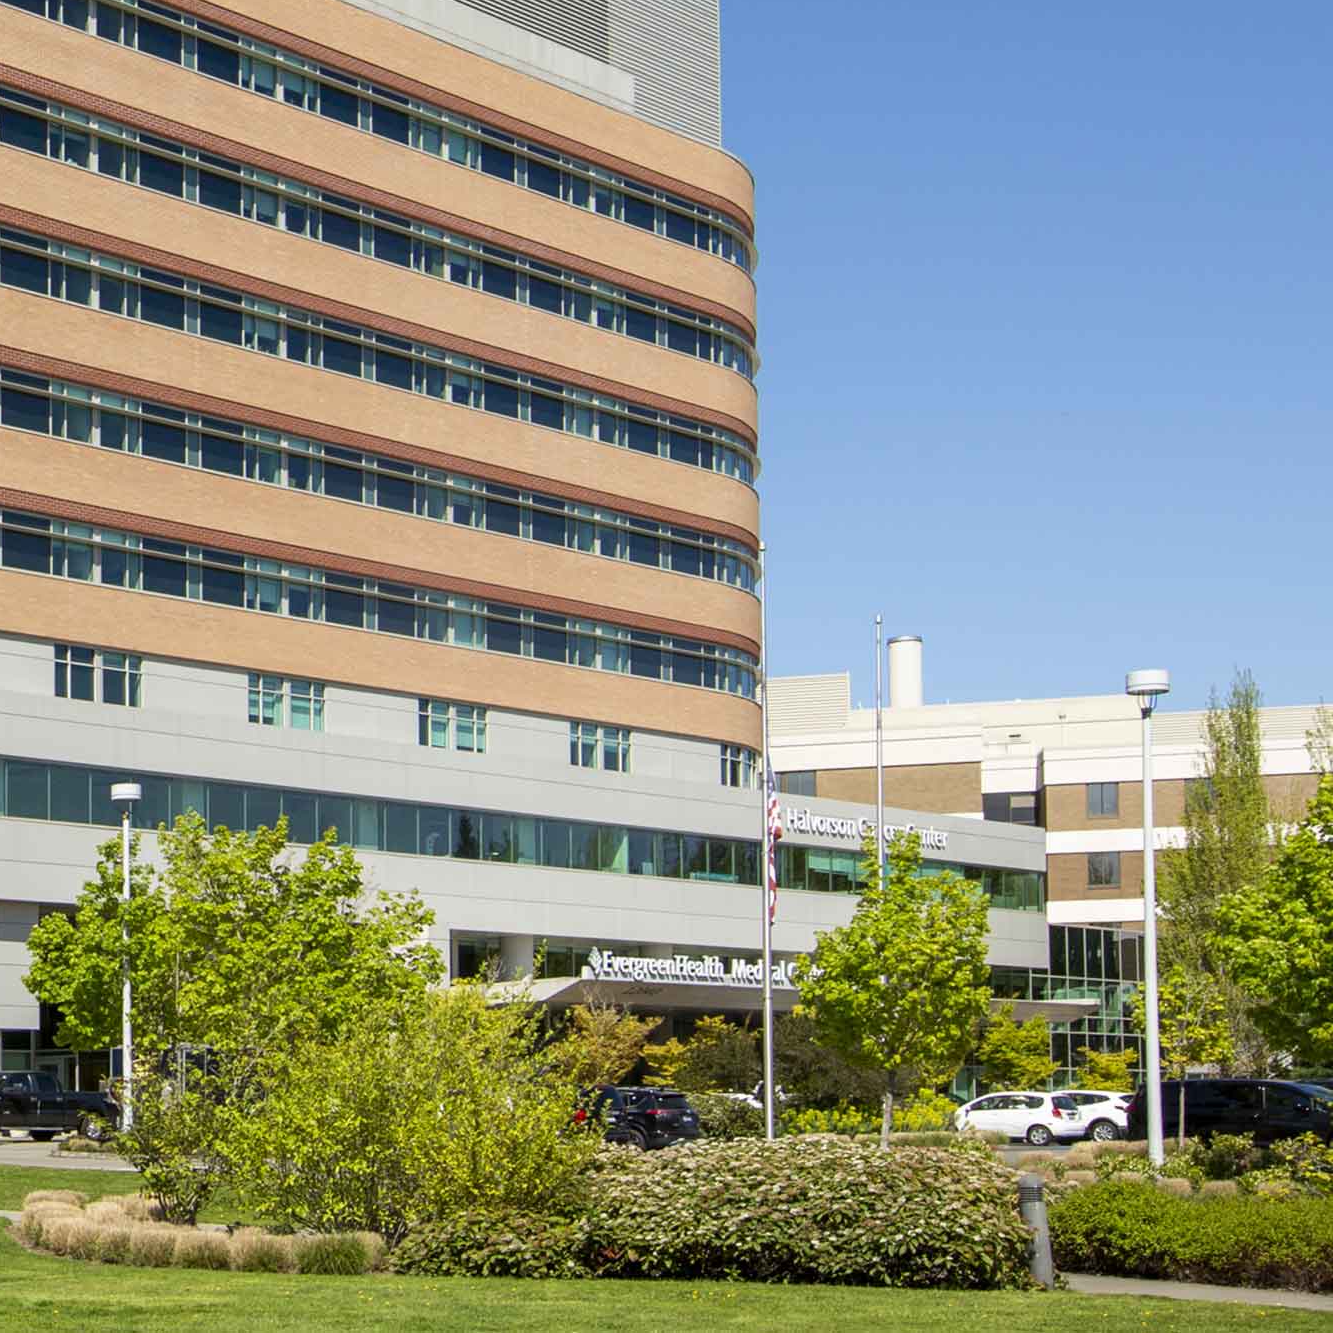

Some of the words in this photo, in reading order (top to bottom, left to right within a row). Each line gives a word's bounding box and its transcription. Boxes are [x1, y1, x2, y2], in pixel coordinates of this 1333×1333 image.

[786, 807, 855, 836] Halvorson
[602, 951, 725, 979] EvergreenHealth
[731, 958, 785, 980] Medal
